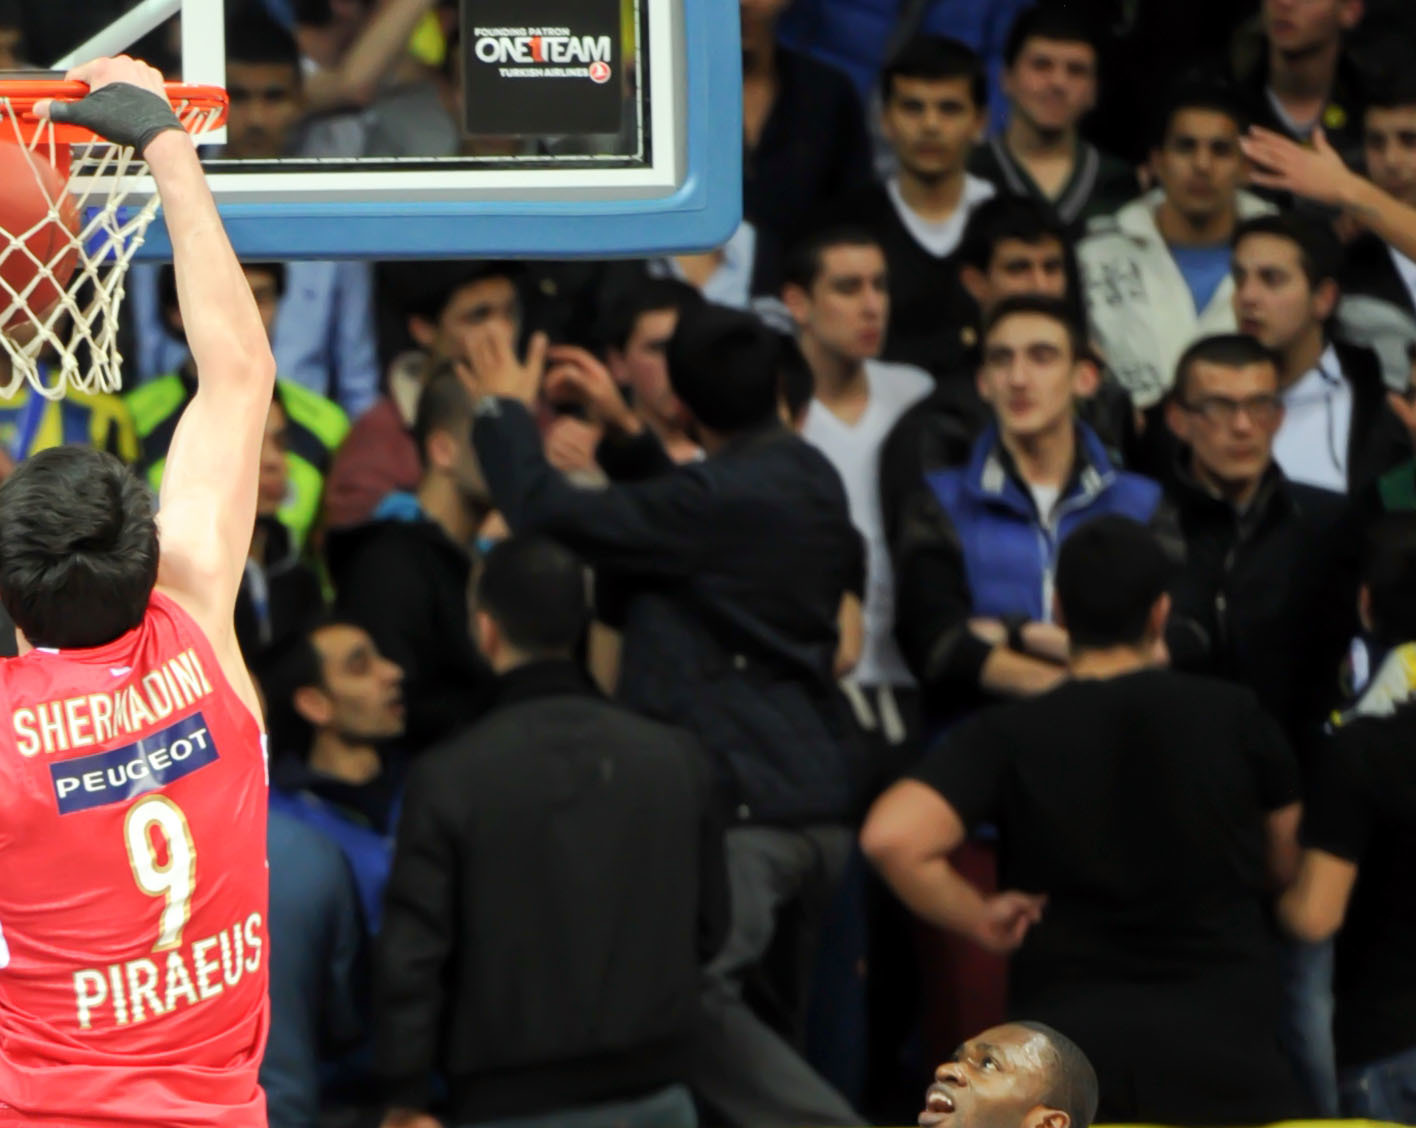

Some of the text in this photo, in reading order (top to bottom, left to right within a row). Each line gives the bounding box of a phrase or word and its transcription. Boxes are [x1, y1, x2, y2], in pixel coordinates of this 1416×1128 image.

[474, 27, 570, 36] FOUNDING PATRON
[499, 67, 589, 77] TURKISH AIRLINES
[12, 648, 213, 758] SHERMADINI
[55, 727, 208, 799] PEUGEOT
[123, 794, 197, 952] 9
[72, 912, 262, 1029] PIRAEUS
